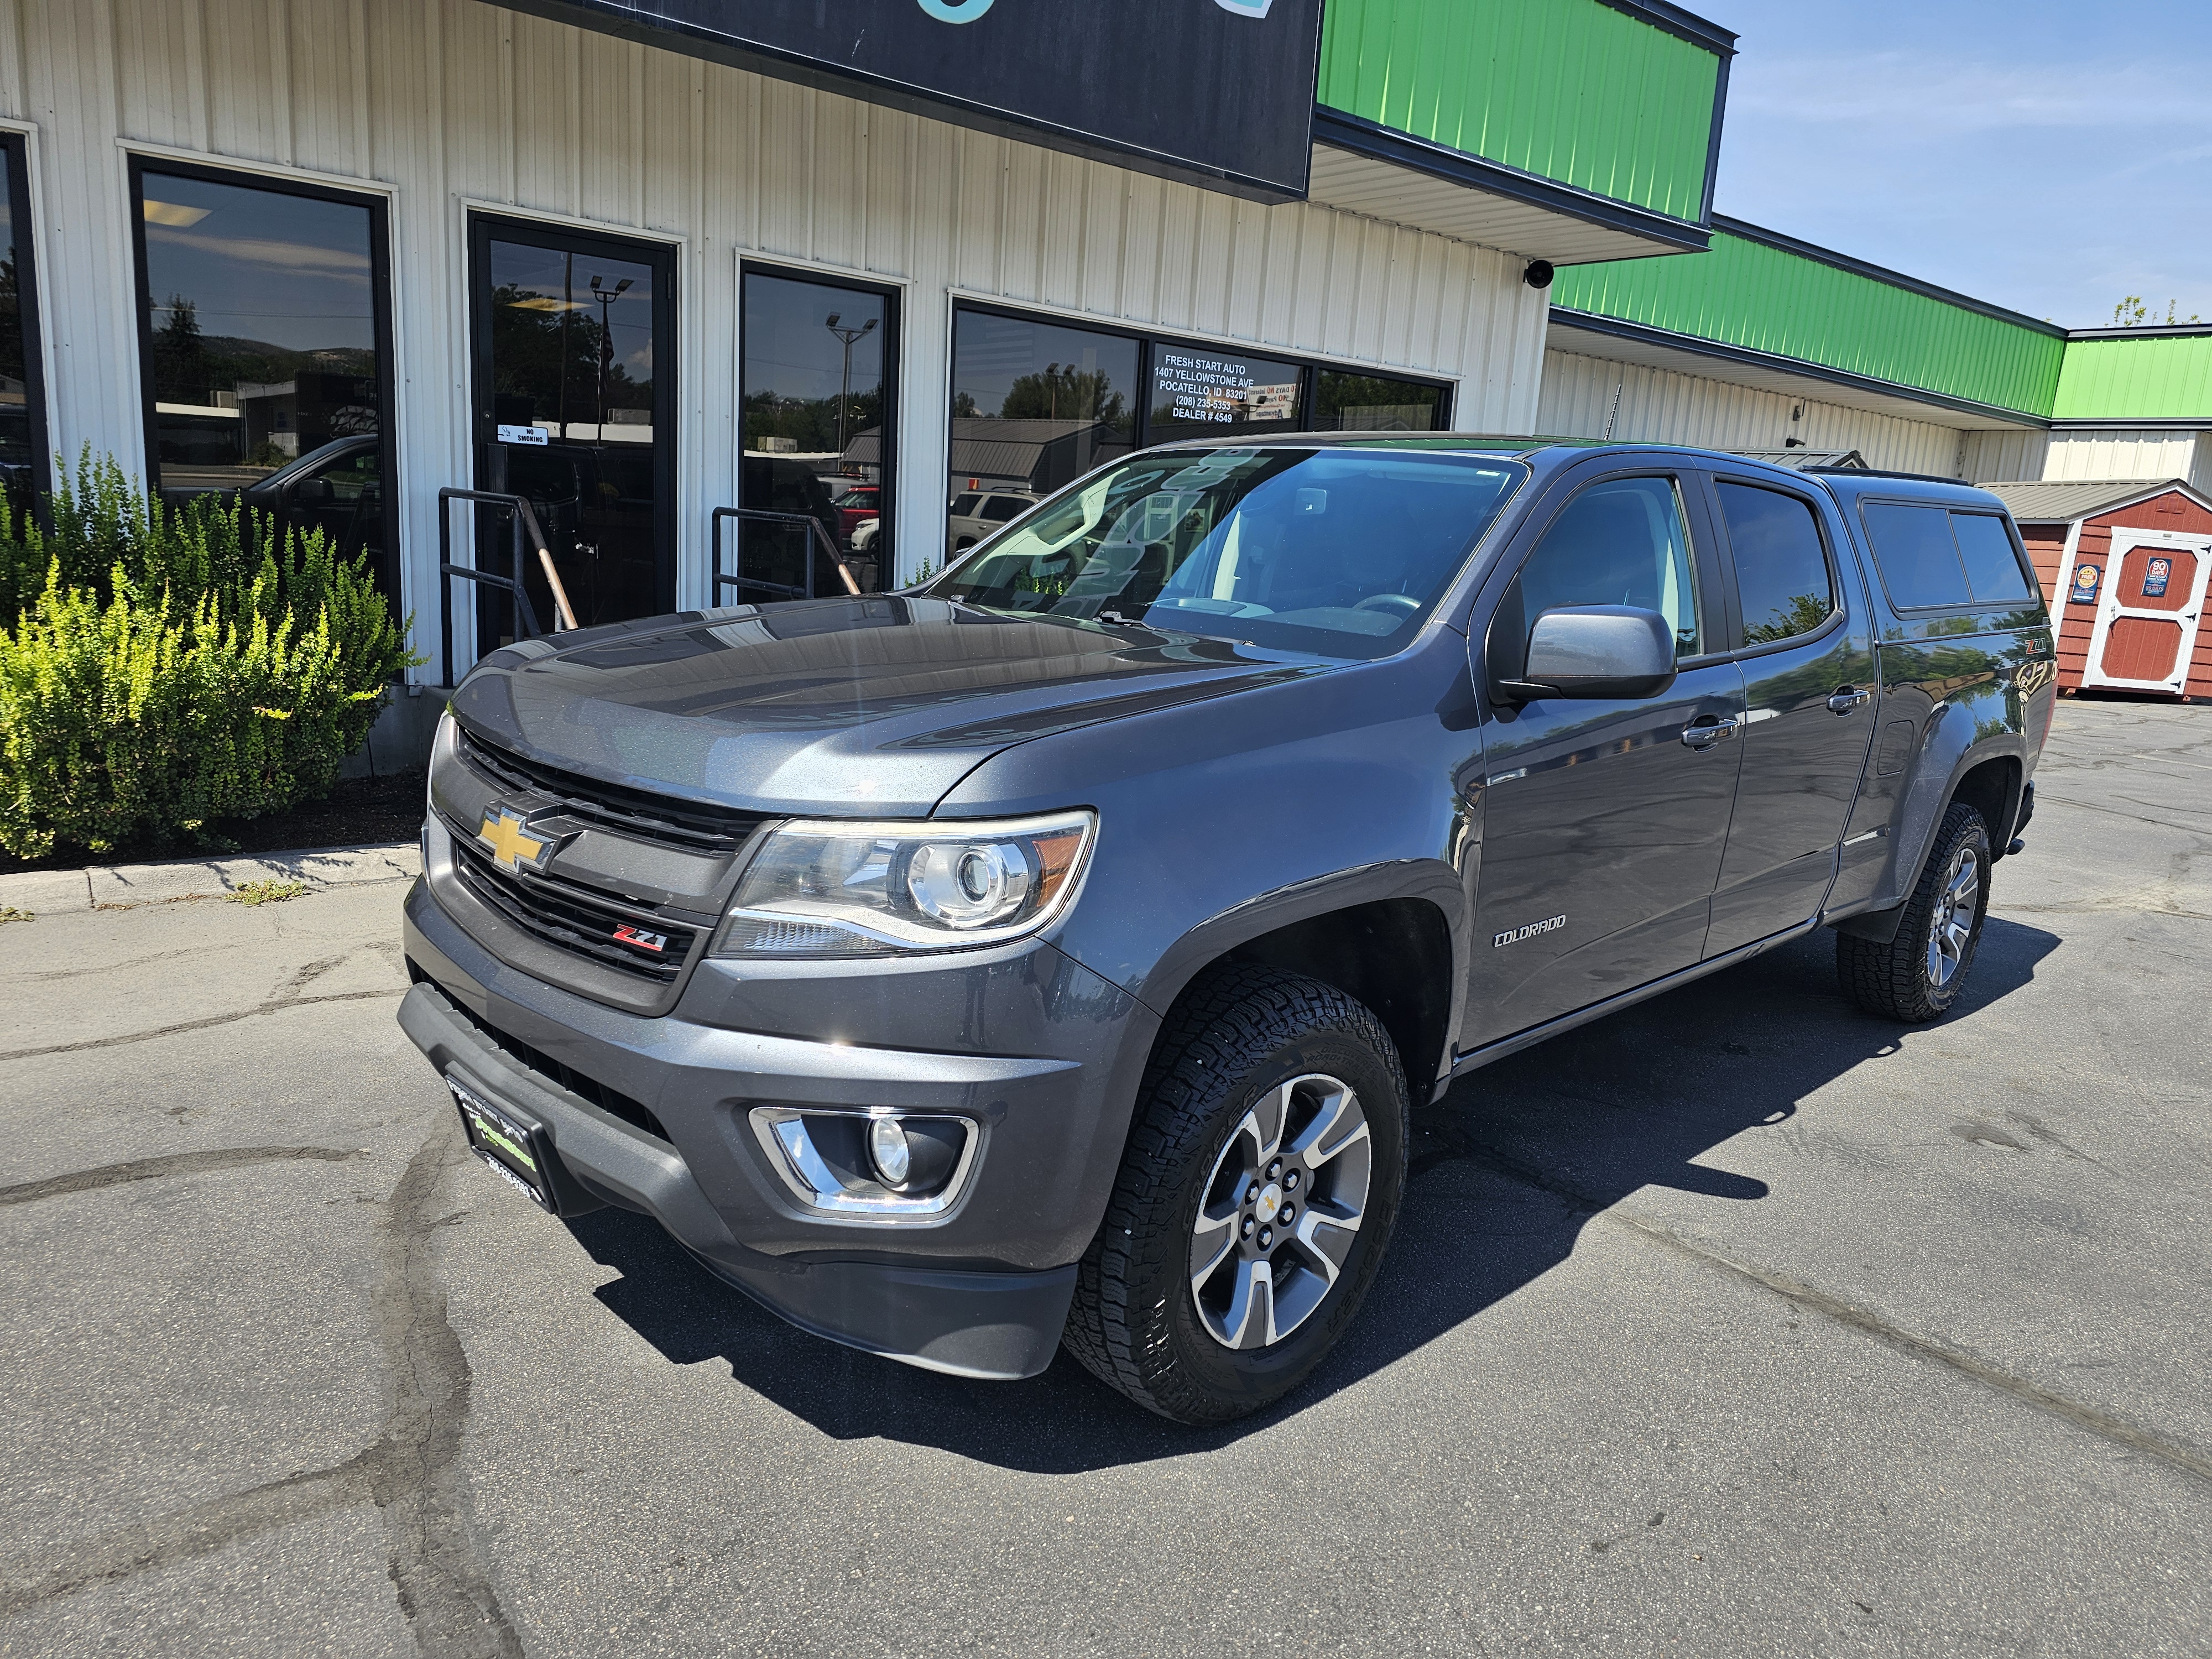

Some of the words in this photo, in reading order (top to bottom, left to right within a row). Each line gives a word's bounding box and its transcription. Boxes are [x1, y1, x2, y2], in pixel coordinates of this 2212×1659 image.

[1165, 354, 1194, 368] FRESH
[1195, 359, 1222, 372] START
[1223, 363, 1246, 375] AUTO
[1155, 366, 1173, 378] 1407
[1175, 369, 1237, 387] YELLOWSTONE
[1238, 378, 1254, 388] AVE
[1160, 380, 1212, 397] POCATELLO,
[1213, 387, 1222, 397] ID
[1225, 389, 1247, 400] 83201
[1176, 395, 1196, 408] (208)
[1197, 398, 1231, 410] 235-5353
[1172, 407, 1206, 420] DEALER
[1207, 411, 1213, 421] #
[1214, 413, 1233, 423] 4549
[2152, 561, 2166, 571] 90
[2025, 638, 2047, 655] Z71
[613, 924, 667, 952] Z71
[1493, 914, 1566, 948] COLORADO
[1182, 1082, 1259, 1232] COOPER
